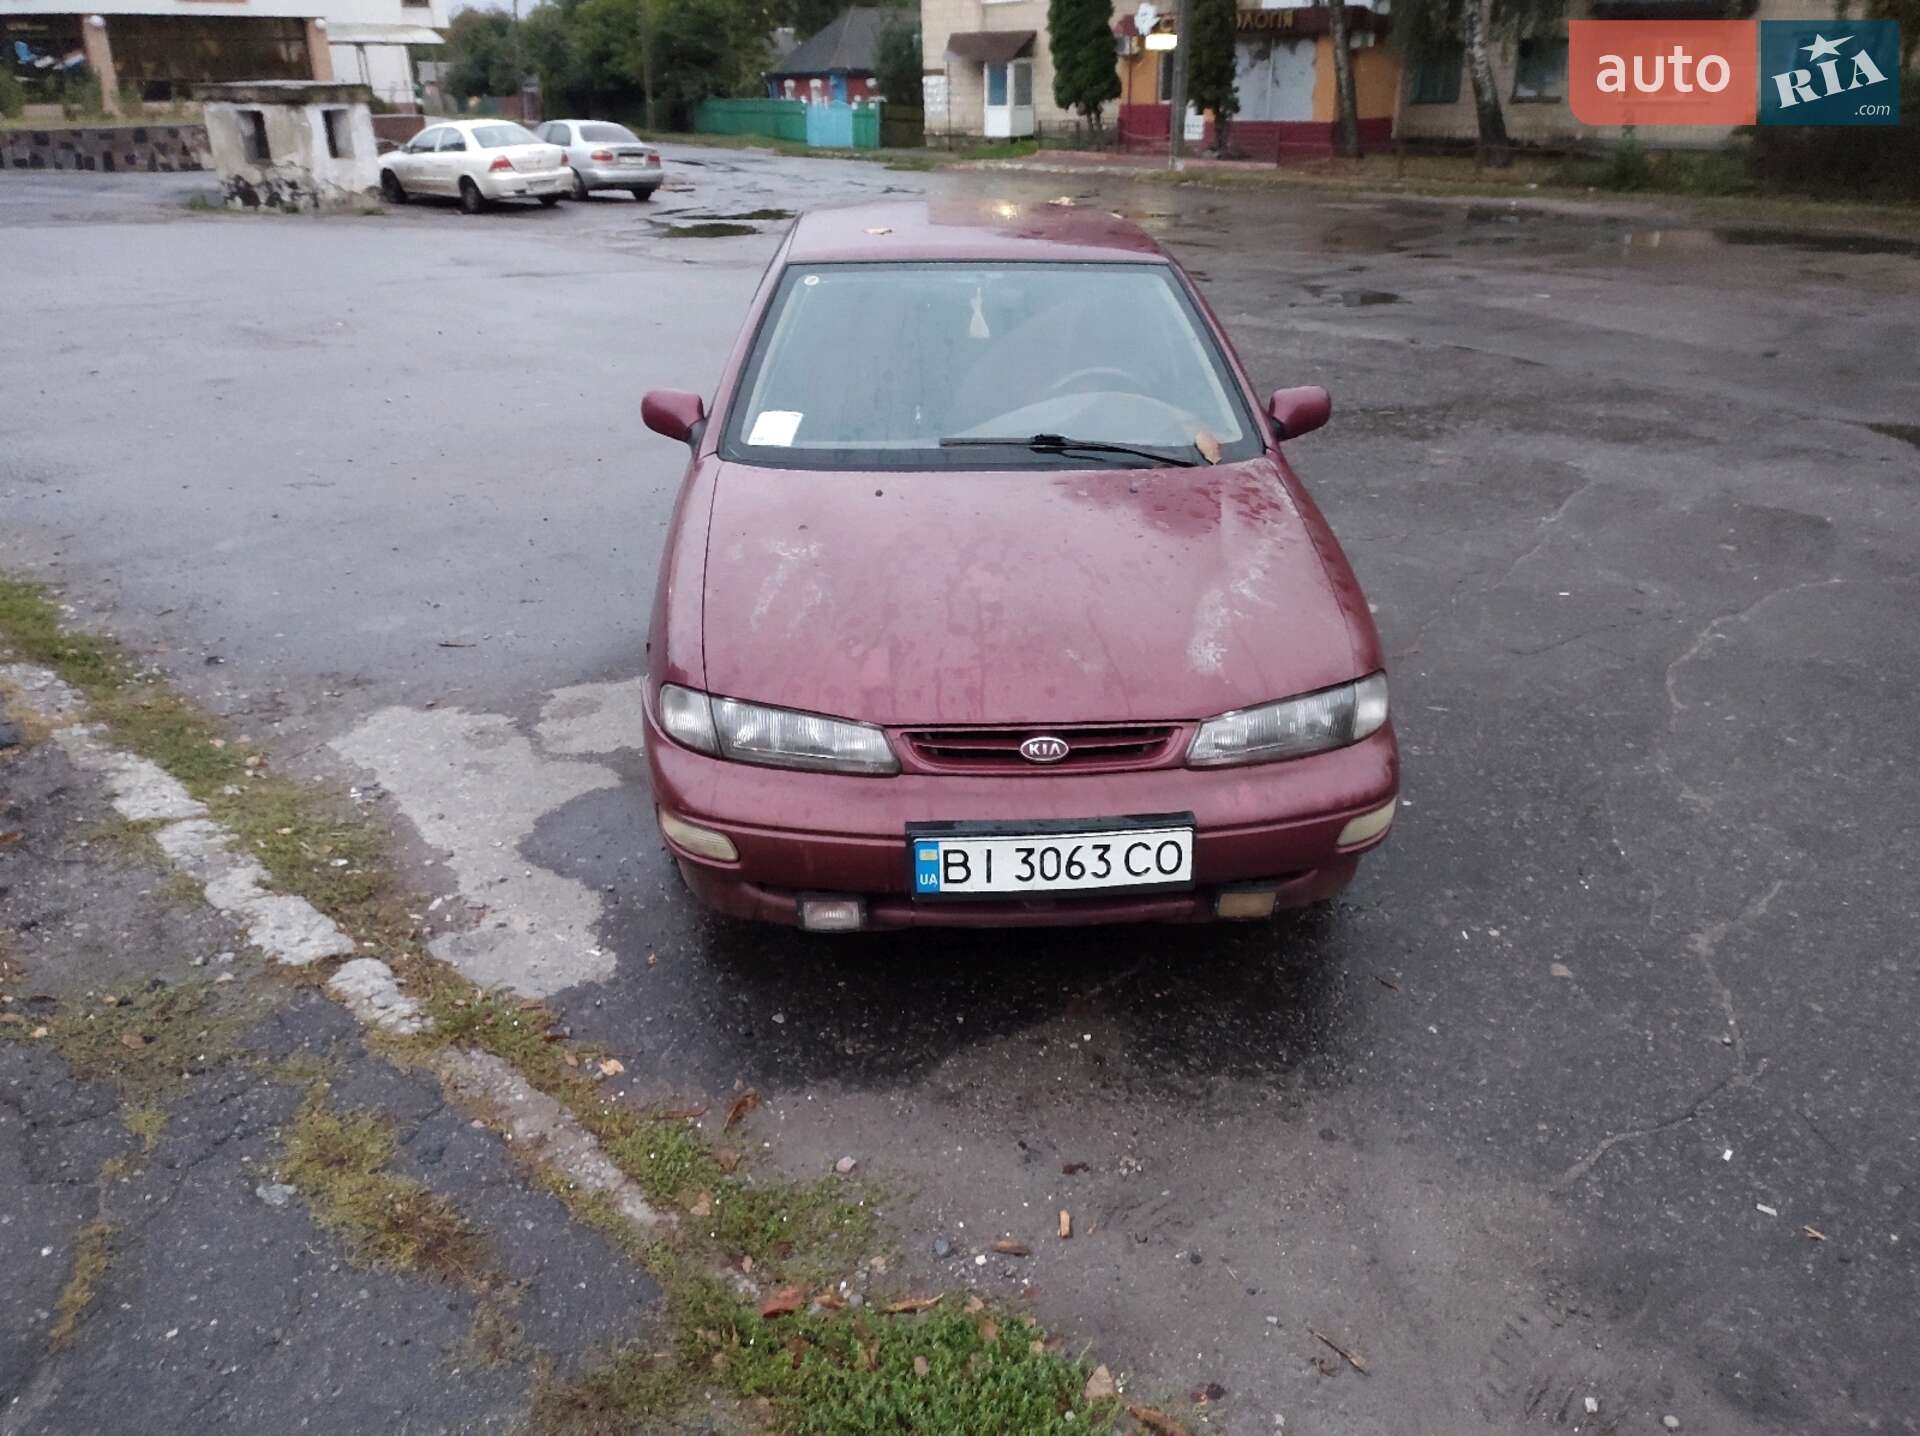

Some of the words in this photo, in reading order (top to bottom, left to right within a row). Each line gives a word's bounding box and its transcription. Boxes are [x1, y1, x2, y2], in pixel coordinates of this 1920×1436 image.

[1028, 743, 1062, 756] KIA
[919, 873, 938, 886] UA
[1014, 843, 1112, 883] 3063
[1123, 839, 1184, 877] CO
